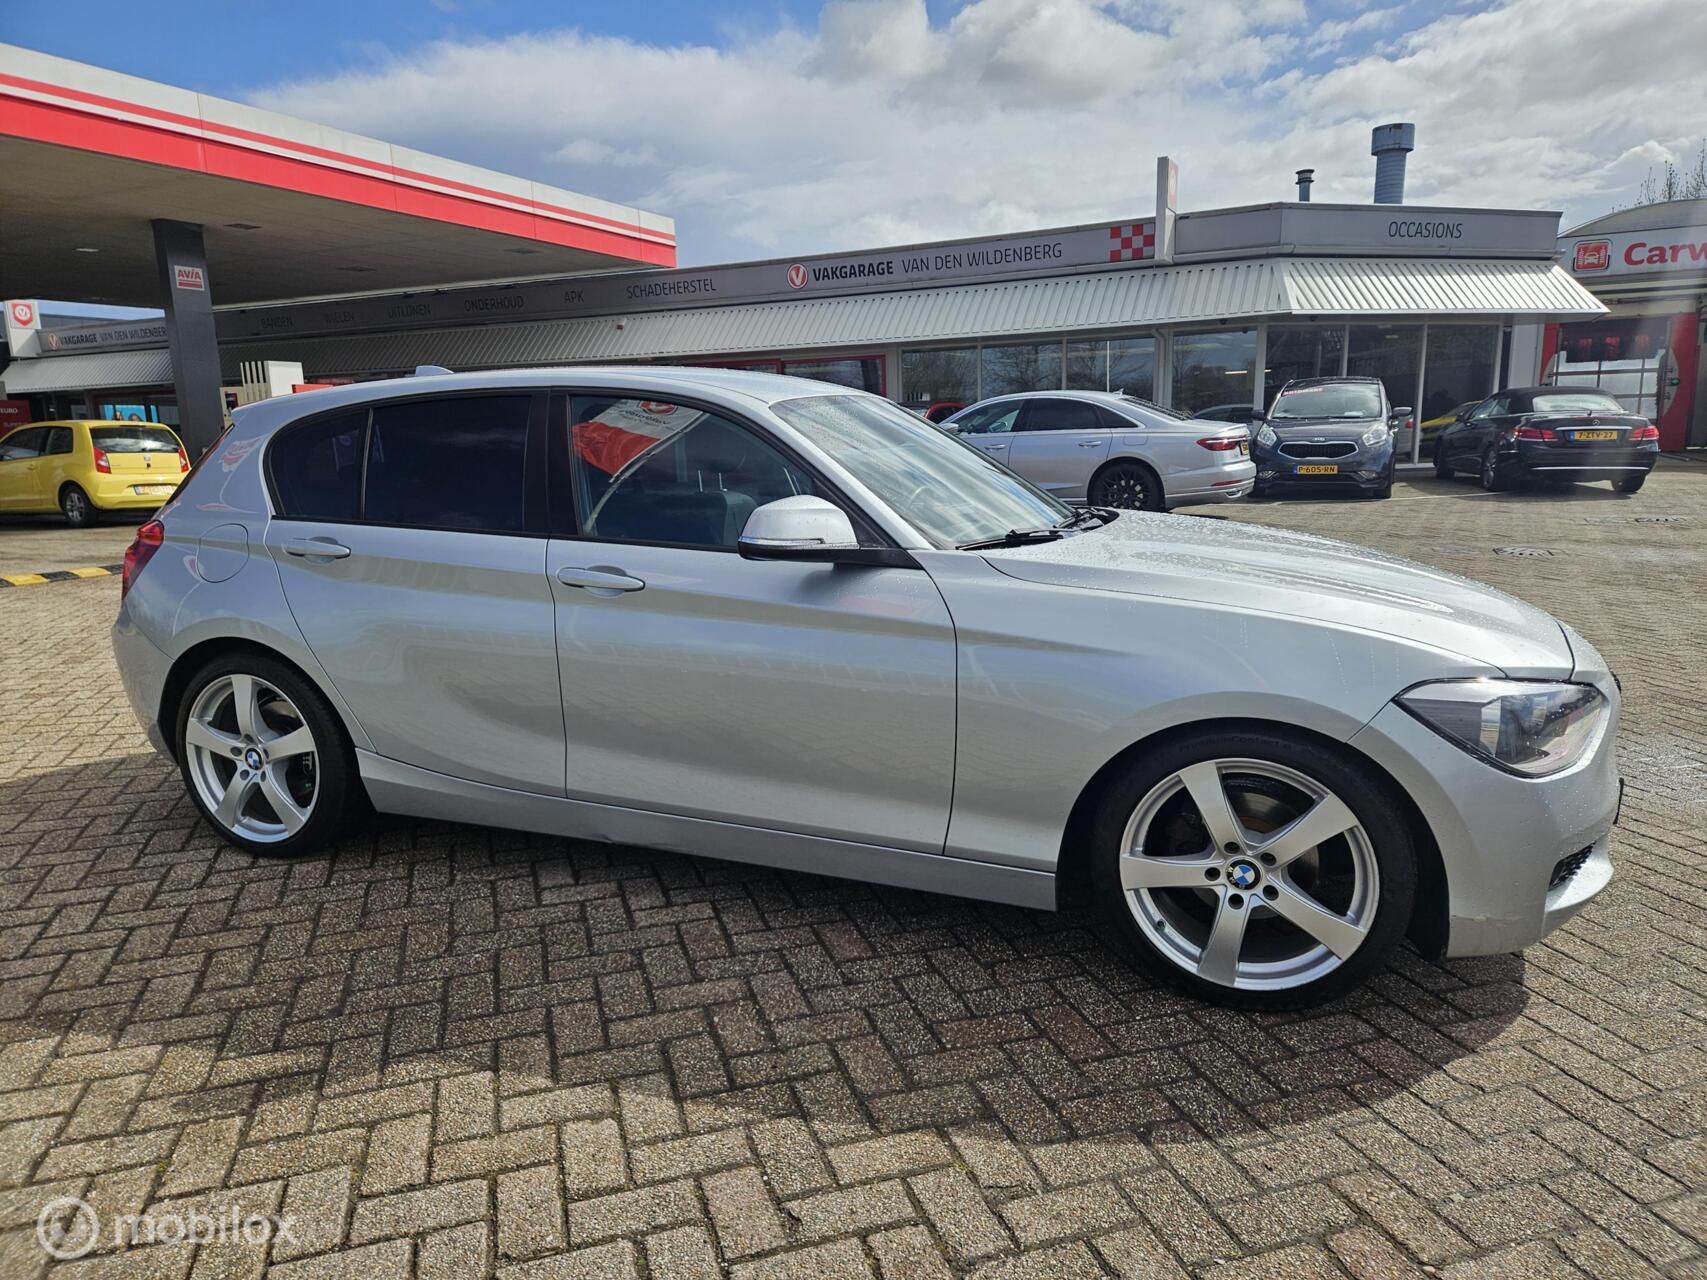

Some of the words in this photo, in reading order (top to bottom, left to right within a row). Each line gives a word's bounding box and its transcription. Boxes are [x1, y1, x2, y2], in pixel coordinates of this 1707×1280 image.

[1388, 221, 1463, 239] OCCASIONS
[812, 260, 894, 281] VAKGARAGE
[901, 256, 930, 273] VAN
[935, 254, 962, 271] DEN
[967, 242, 1063, 267] WILDENBERG
[626, 278, 717, 299] SCHADEHERSTEL
[463, 295, 525, 311] ONDERHOUD
[564, 290, 584, 304] APK
[59, 333, 98, 346] VAKGARAGE
[1298, 465, 1336, 473] P-605-RN
